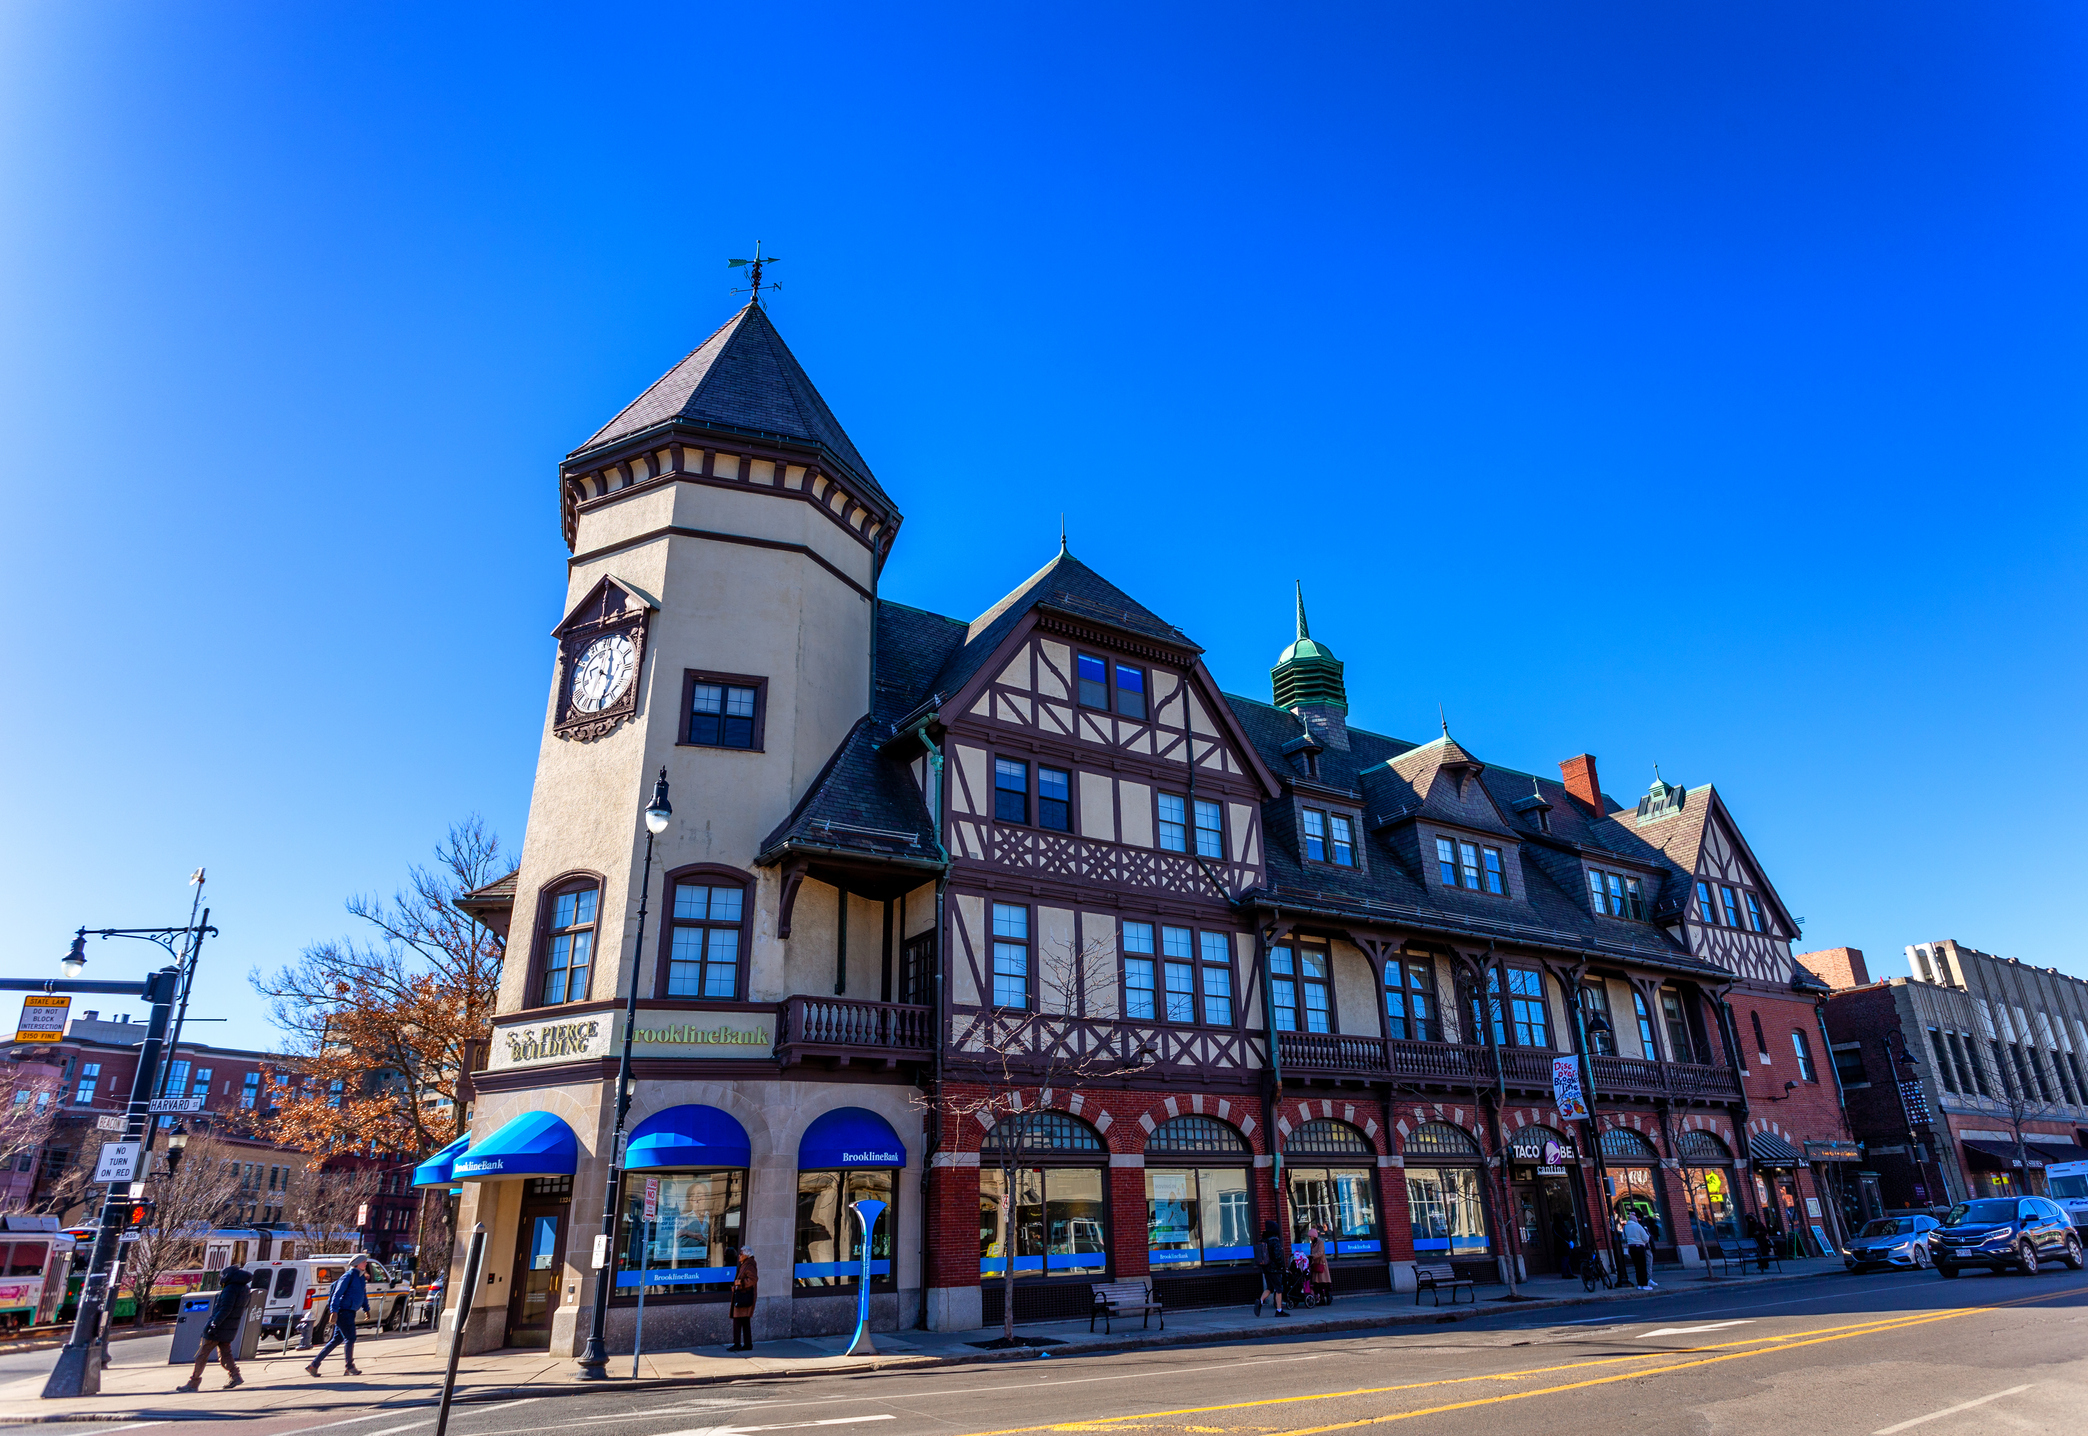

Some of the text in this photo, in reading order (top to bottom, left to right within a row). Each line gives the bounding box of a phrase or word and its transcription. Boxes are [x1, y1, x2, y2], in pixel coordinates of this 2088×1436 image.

[540, 1020, 598, 1041] PIERCE
[511, 1037, 588, 1061] BUILDING
[1554, 1061, 1573, 1071] Disc
[1558, 1070, 1577, 1078] over
[150, 1099, 190, 1111] HARVARD
[98, 1116, 121, 1130] BEACON
[115, 1147, 127, 1155] NO
[1513, 1145, 1540, 1159] TACO
[843, 1151, 899, 1162] BrooklineBank
[109, 1158, 129, 1166] TURN
[101, 1168, 130, 1177] ON RED
[1537, 1165, 1566, 1174] cantina
[647, 1190, 655, 1199] NO
[653, 1272, 700, 1282] BrooklineBank
